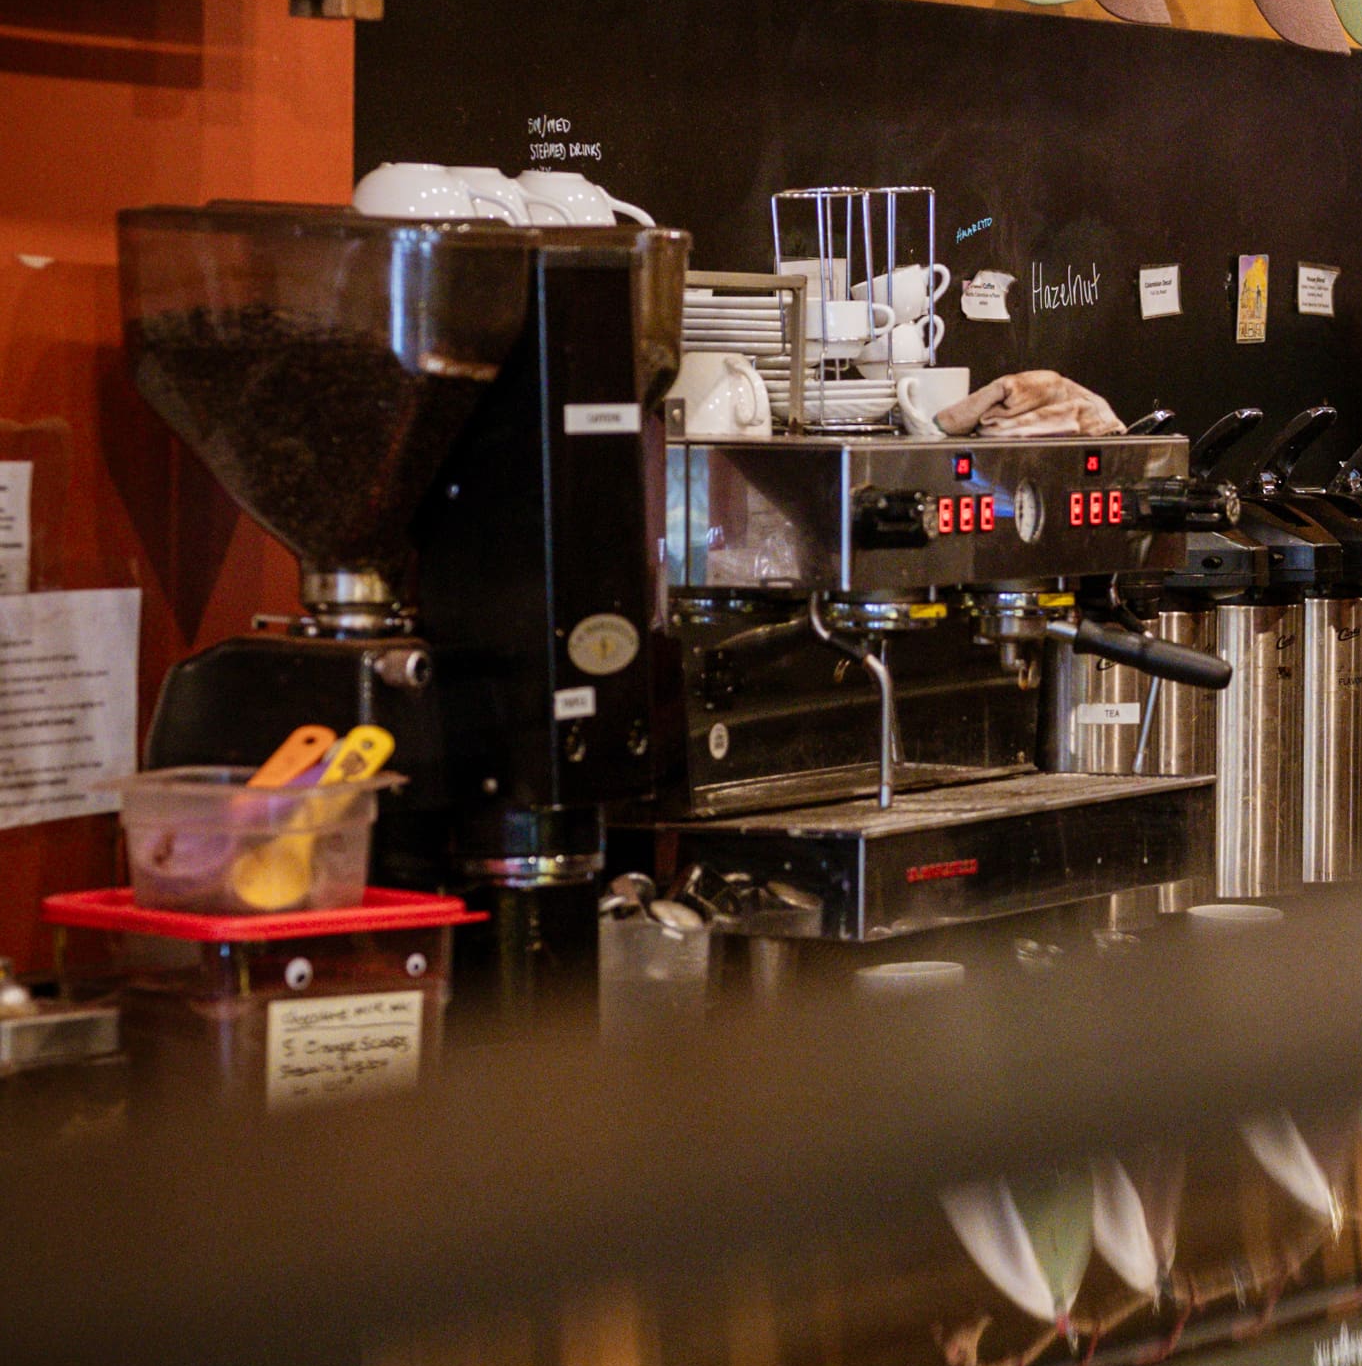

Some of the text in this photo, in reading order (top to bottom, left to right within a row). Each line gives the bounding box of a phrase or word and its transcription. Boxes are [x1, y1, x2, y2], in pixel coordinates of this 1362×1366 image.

[530, 142, 602, 160] STEAMED DRINKS
[1032, 261, 1100, 314] Hazelnut
[1104, 709, 1120, 719] TEA
